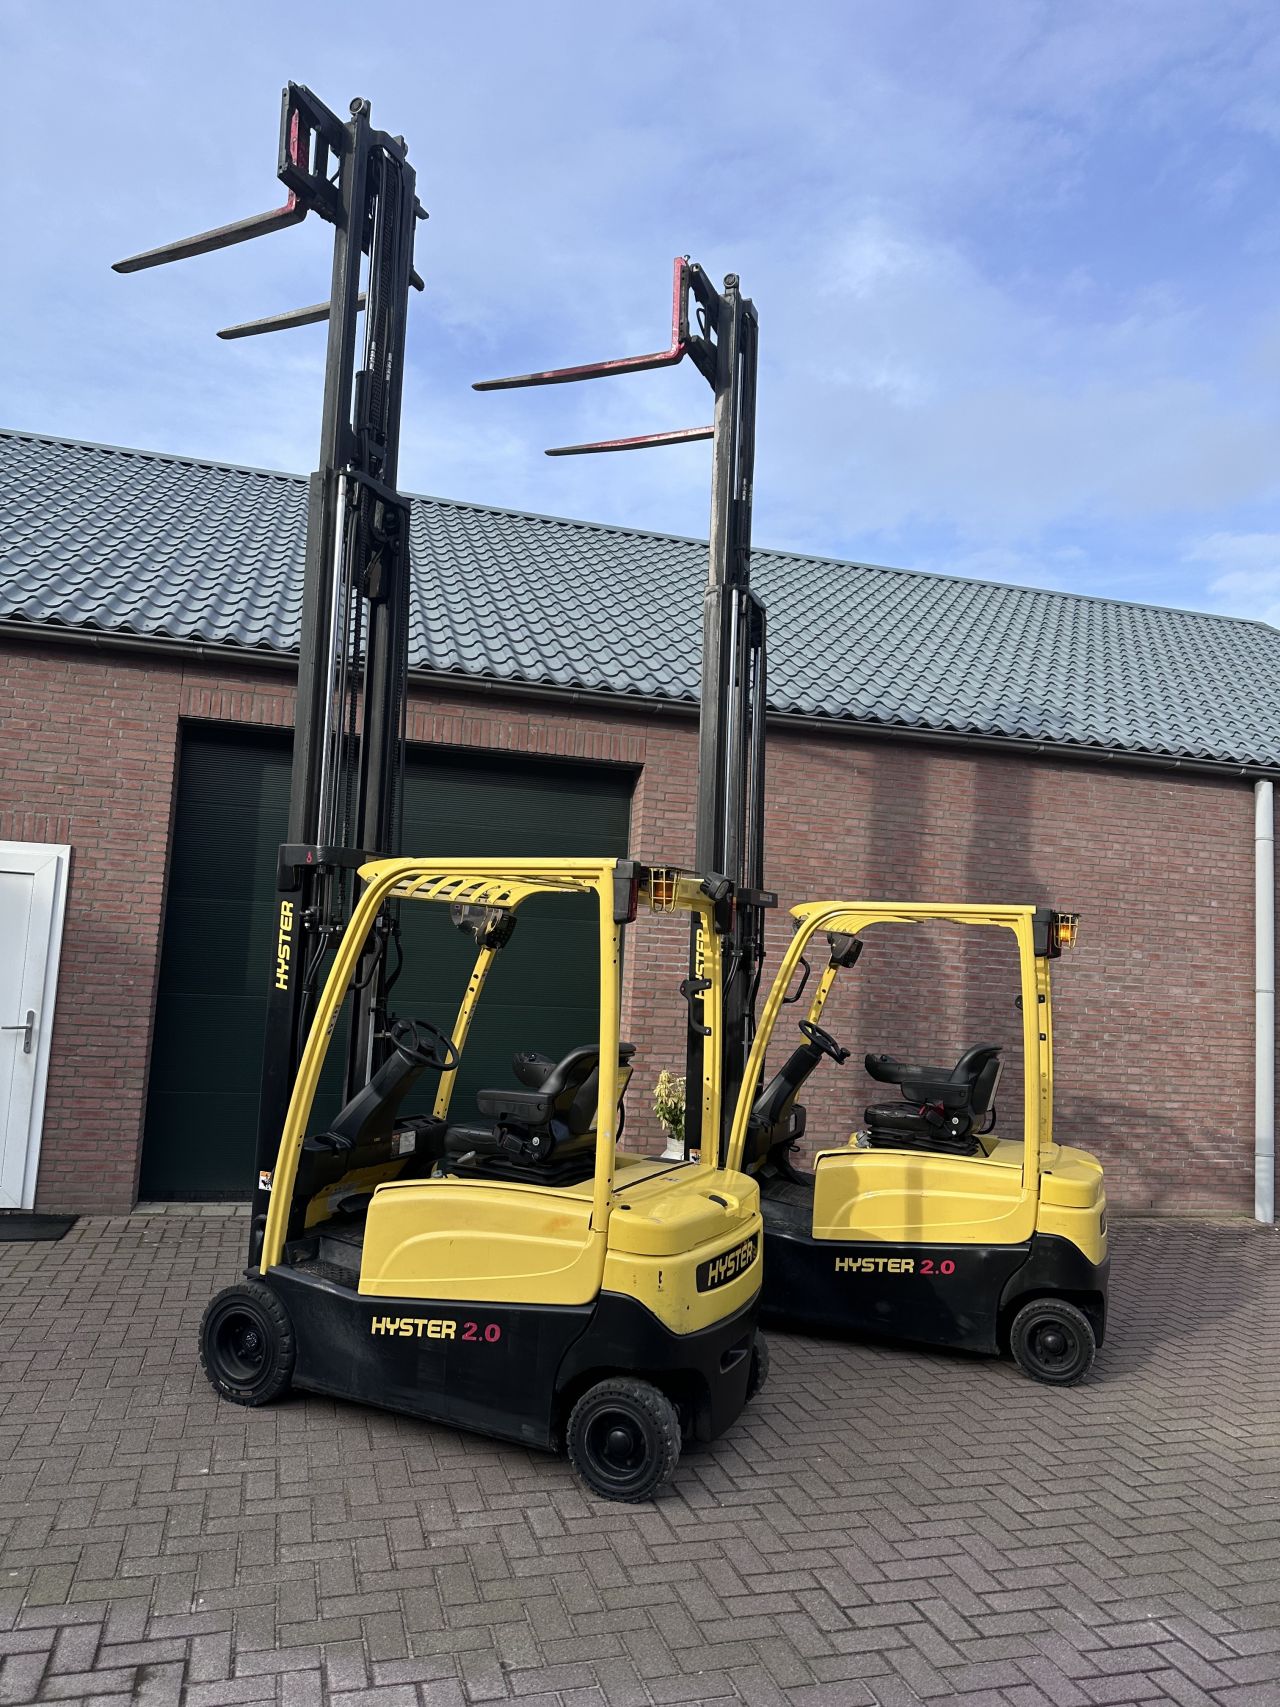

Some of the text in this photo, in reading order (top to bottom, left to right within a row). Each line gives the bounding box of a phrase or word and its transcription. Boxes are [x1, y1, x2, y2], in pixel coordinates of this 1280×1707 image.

[275, 900, 294, 990] HYSTER
[707, 1240, 754, 1287] HYSTER
[835, 1257, 955, 1275] HYSTER 2.0
[371, 1316, 501, 1343] HYSTER 2.0
